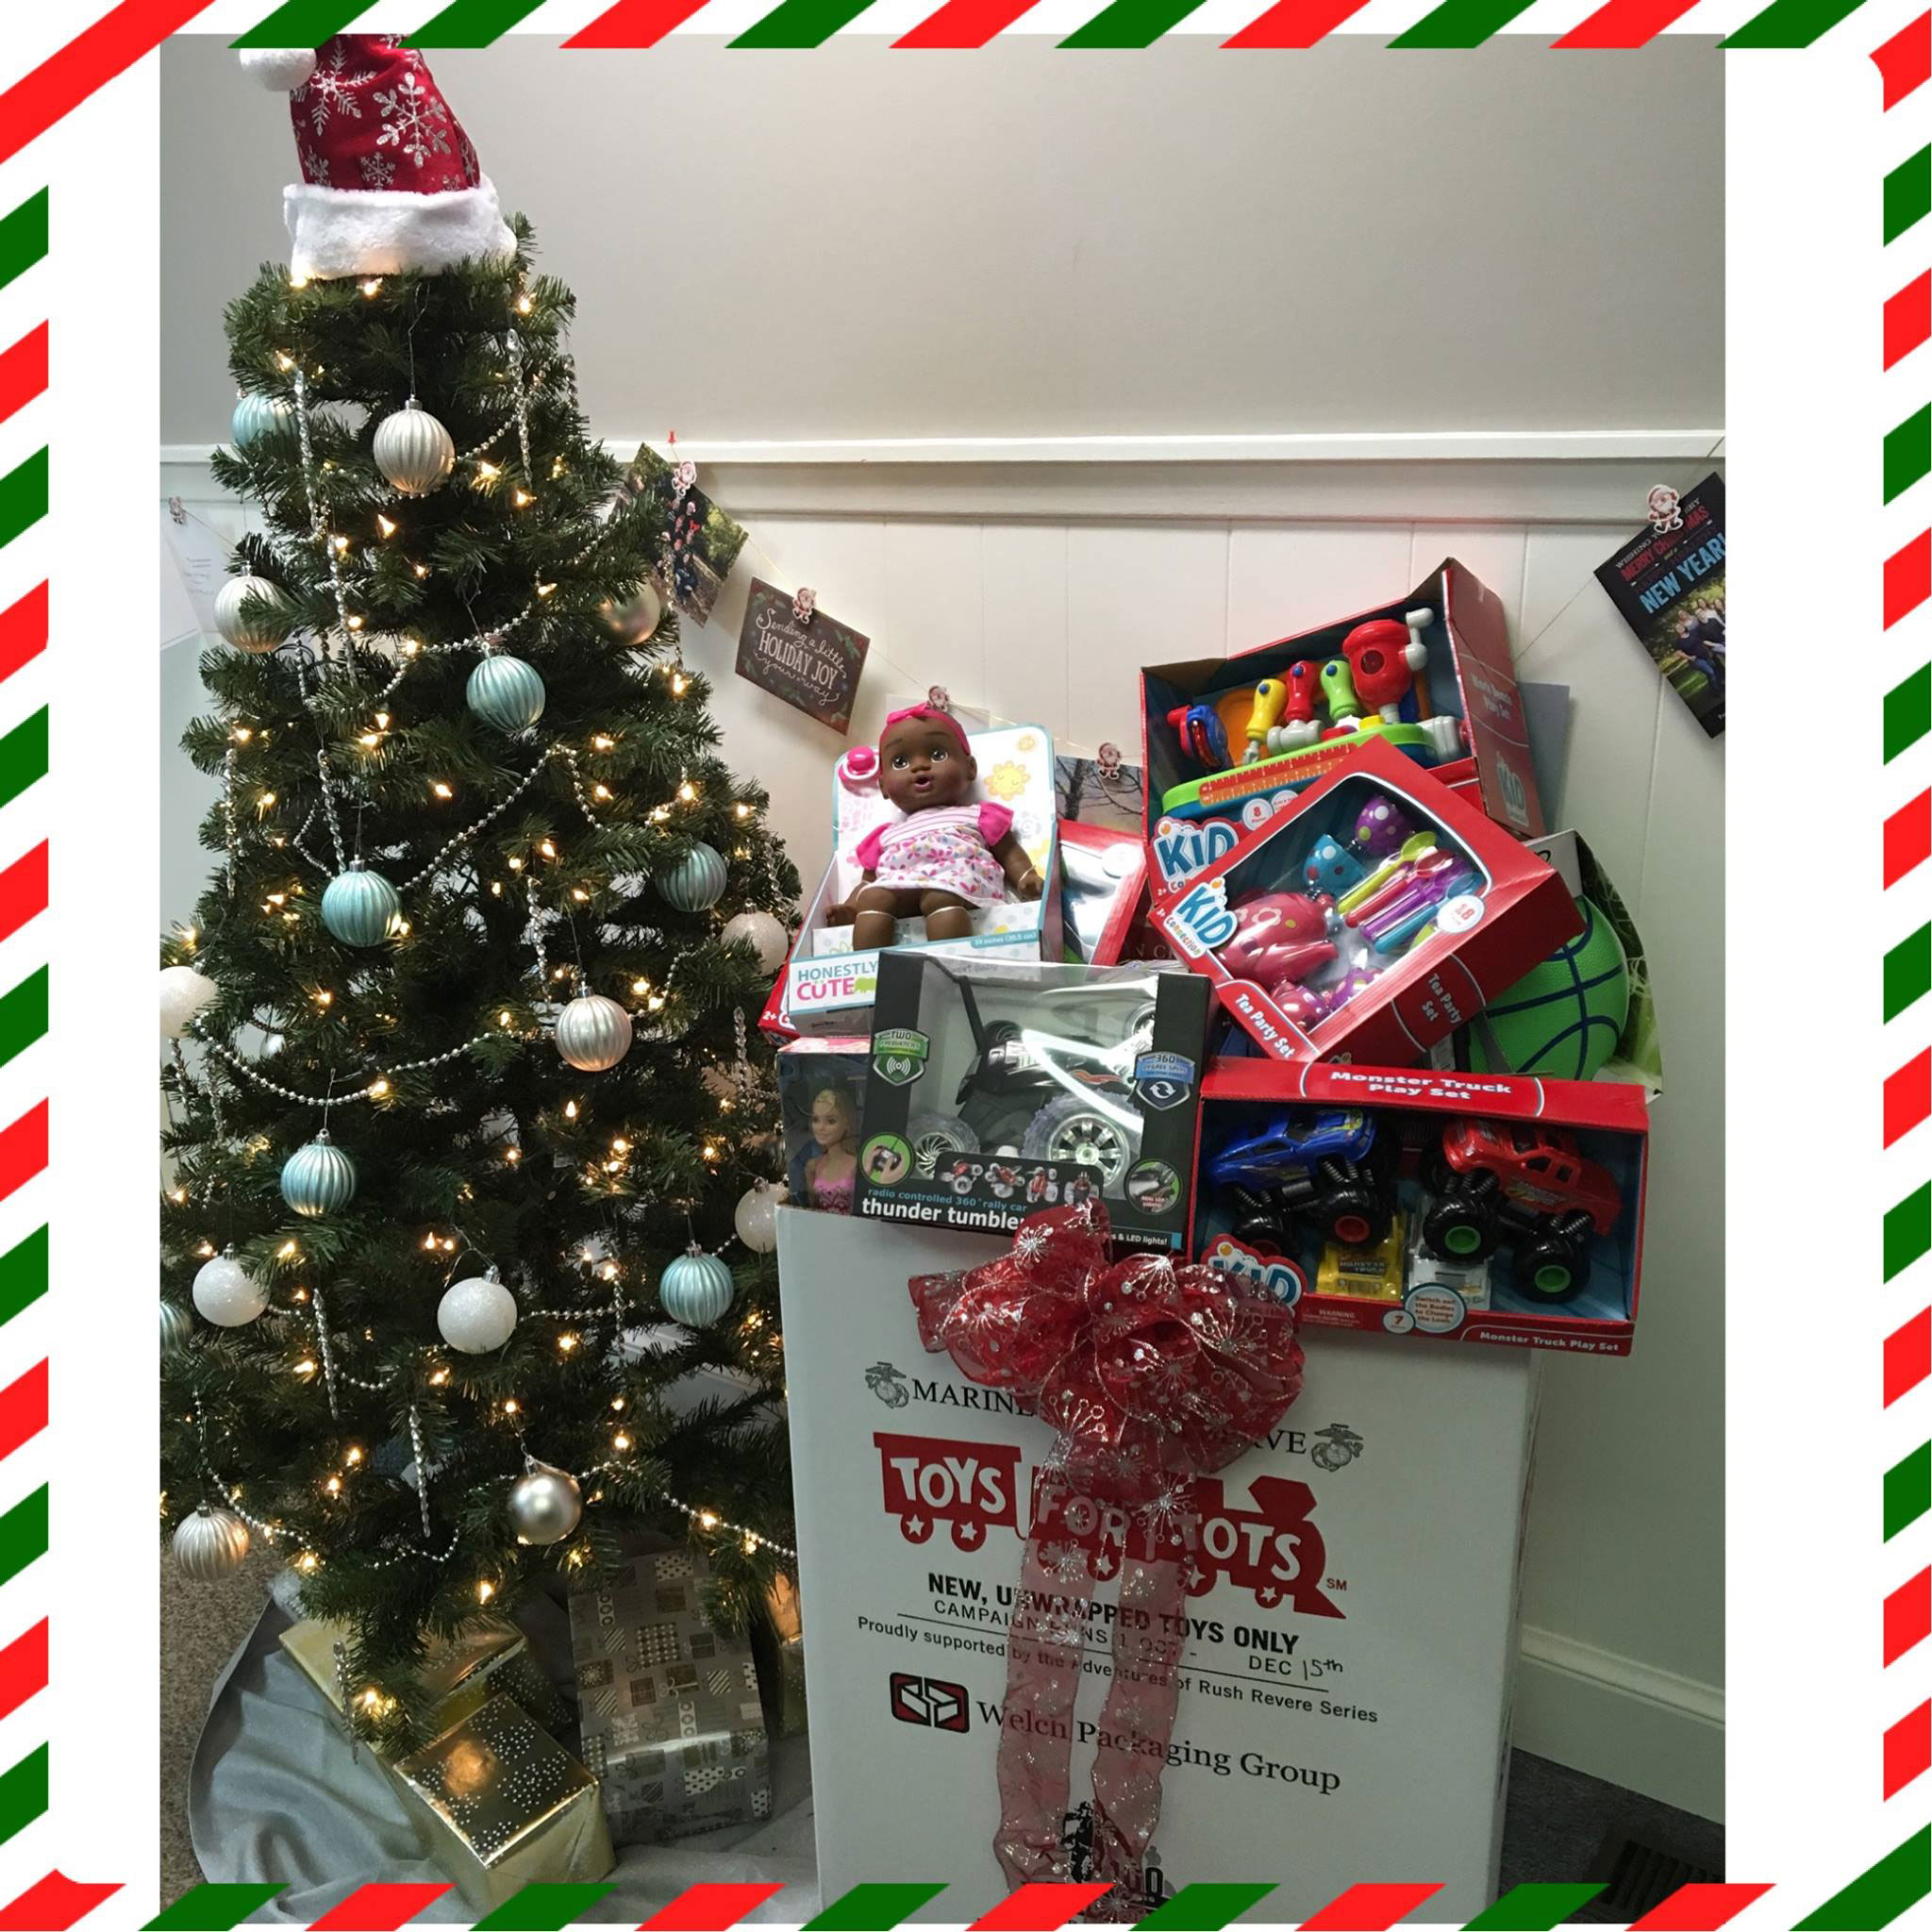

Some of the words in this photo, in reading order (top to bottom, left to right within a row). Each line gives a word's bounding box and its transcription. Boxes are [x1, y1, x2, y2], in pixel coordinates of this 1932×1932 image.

[1621, 547, 1655, 581] MERRY
[1640, 571, 1681, 613] NEW
[756, 608, 808, 649] Sending
[814, 640, 847, 679] little
[758, 630, 812, 676] HOLIDAY
[811, 660, 839, 690] JOY
[755, 651, 796, 679] your
[800, 677, 840, 707] way
[1253, 807, 1262, 818] 8
[1158, 825, 1236, 877] KID
[1176, 886, 1235, 945] KID
[798, 959, 877, 982] HONESTLY
[1422, 1000, 1440, 1022] Set
[1427, 973, 1444, 996] Tea
[1441, 992, 1462, 1024] Party
[763, 1010, 777, 1021] 2+
[1235, 992, 1255, 1015] Tea
[1250, 1009, 1279, 1042] Party
[1274, 1037, 1296, 1059] Set
[891, 1030, 912, 1040] TWO
[1155, 1054, 1176, 1064] 360
[1330, 1071, 1434, 1086] Monster
[1440, 1078, 1512, 1094] Truck
[1369, 1083, 1423, 1097] Play
[1429, 1088, 1472, 1100] Set
[861, 1197, 941, 1223] thunder
[868, 1188, 896, 1199] radio
[898, 1191, 953, 1205] controlled
[982, 1199, 1008, 1212] rally
[1009, 1203, 1028, 1212] car
[1125, 1234, 1141, 1242] LED
[1142, 1235, 1168, 1246] lights!
[1394, 1314, 1405, 1325] 7
[1479, 1331, 1529, 1343] Monster
[1533, 1336, 1567, 1347] Truck
[1570, 1339, 1596, 1351] Play
[1599, 1341, 1619, 1352] Set
[890, 1457, 1007, 1514] TOYS
[1037, 1482, 1130, 1547] FOR
[1174, 1511, 1302, 1582] TOTS
[1326, 1577, 1348, 1591] SM
[928, 1573, 989, 1606] NEW,
[1158, 1613, 1224, 1643] TOYS
[1233, 1625, 1300, 1656] ONLY
[934, 1599, 1040, 1632] CAMPAIGN
[1249, 1655, 1292, 1675] DEC
[858, 1616, 919, 1642] Proudly
[924, 1629, 1006, 1657] supported
[1012, 1648, 1032, 1665] by
[1038, 1652, 1065, 1669] the
[1178, 1677, 1192, 1691] of
[1199, 1679, 1243, 1701] Rush
[1252, 1688, 1313, 1712] Revere
[1320, 1700, 1378, 1723] Series
[1302, 1657, 1343, 1681] 15th
[976, 1700, 1072, 1740] Welch
[1075, 1720, 1231, 1776] Packaging
[1240, 1752, 1341, 1796] Group
